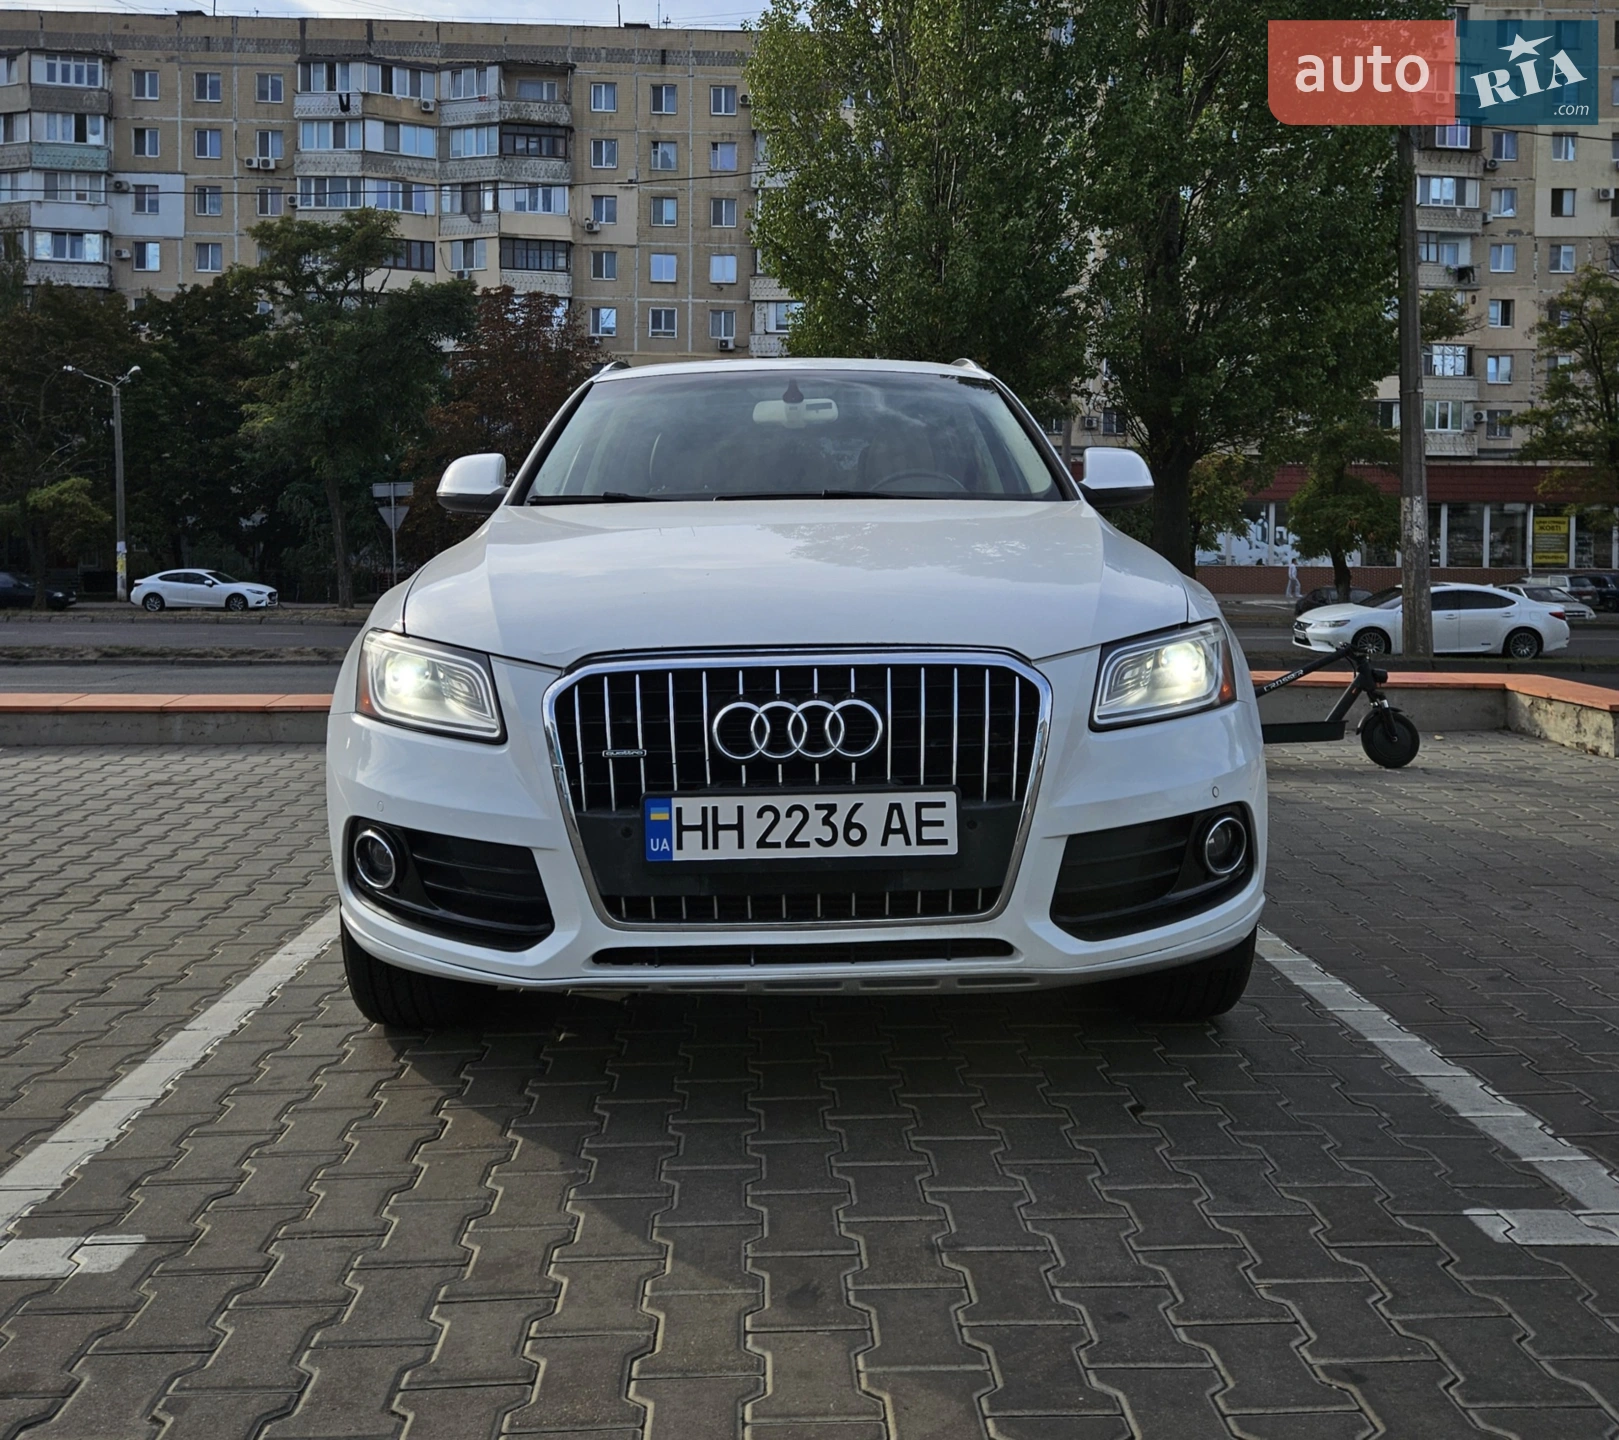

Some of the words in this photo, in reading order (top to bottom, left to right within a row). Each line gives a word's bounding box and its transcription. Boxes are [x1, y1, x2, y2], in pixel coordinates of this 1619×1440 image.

[675, 805, 744, 850] HH
[756, 802, 867, 849] 2236
[880, 801, 949, 847] AE
[650, 838, 671, 852] UA
